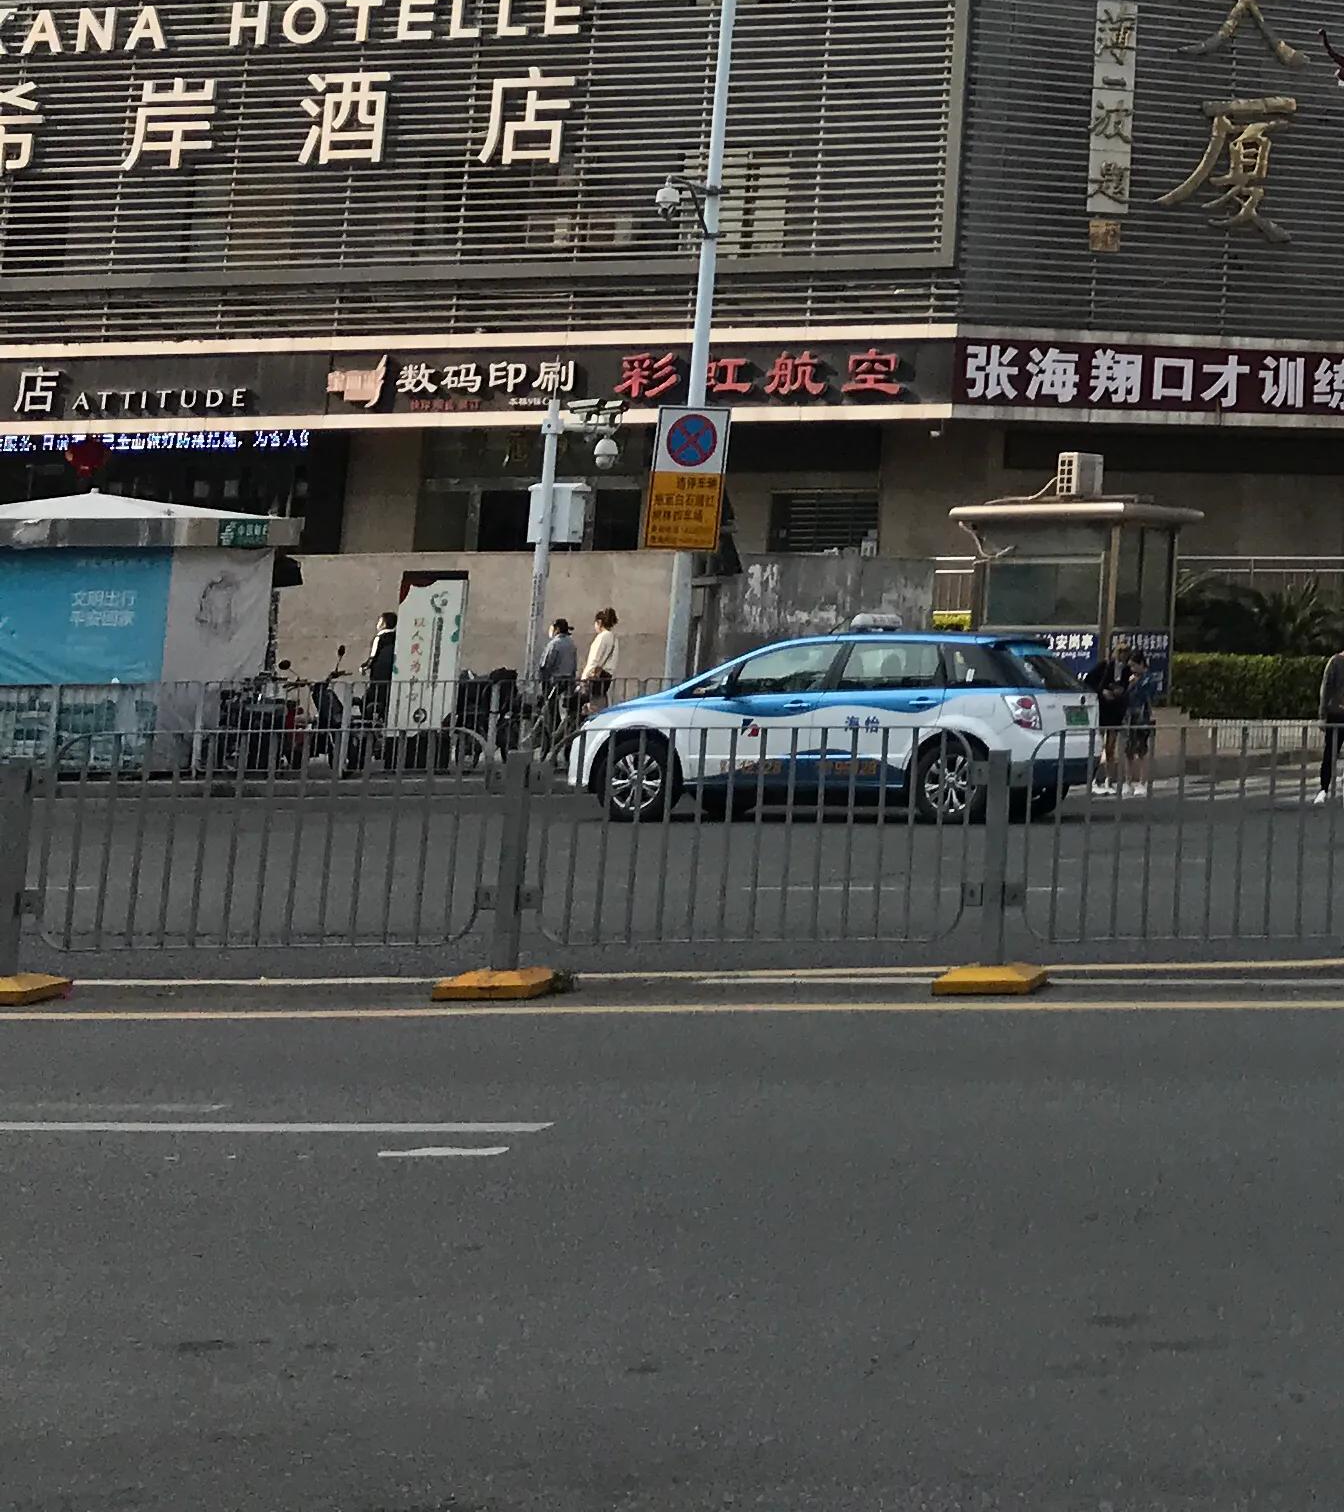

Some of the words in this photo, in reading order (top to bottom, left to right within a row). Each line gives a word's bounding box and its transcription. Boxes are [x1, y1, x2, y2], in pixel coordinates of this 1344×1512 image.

[13, 366, 59, 412] 店
[72, 388, 247, 410] ATTITUDE
[396, 360, 575, 393] 数码印刷
[614, 347, 902, 398] 彩虹航空
